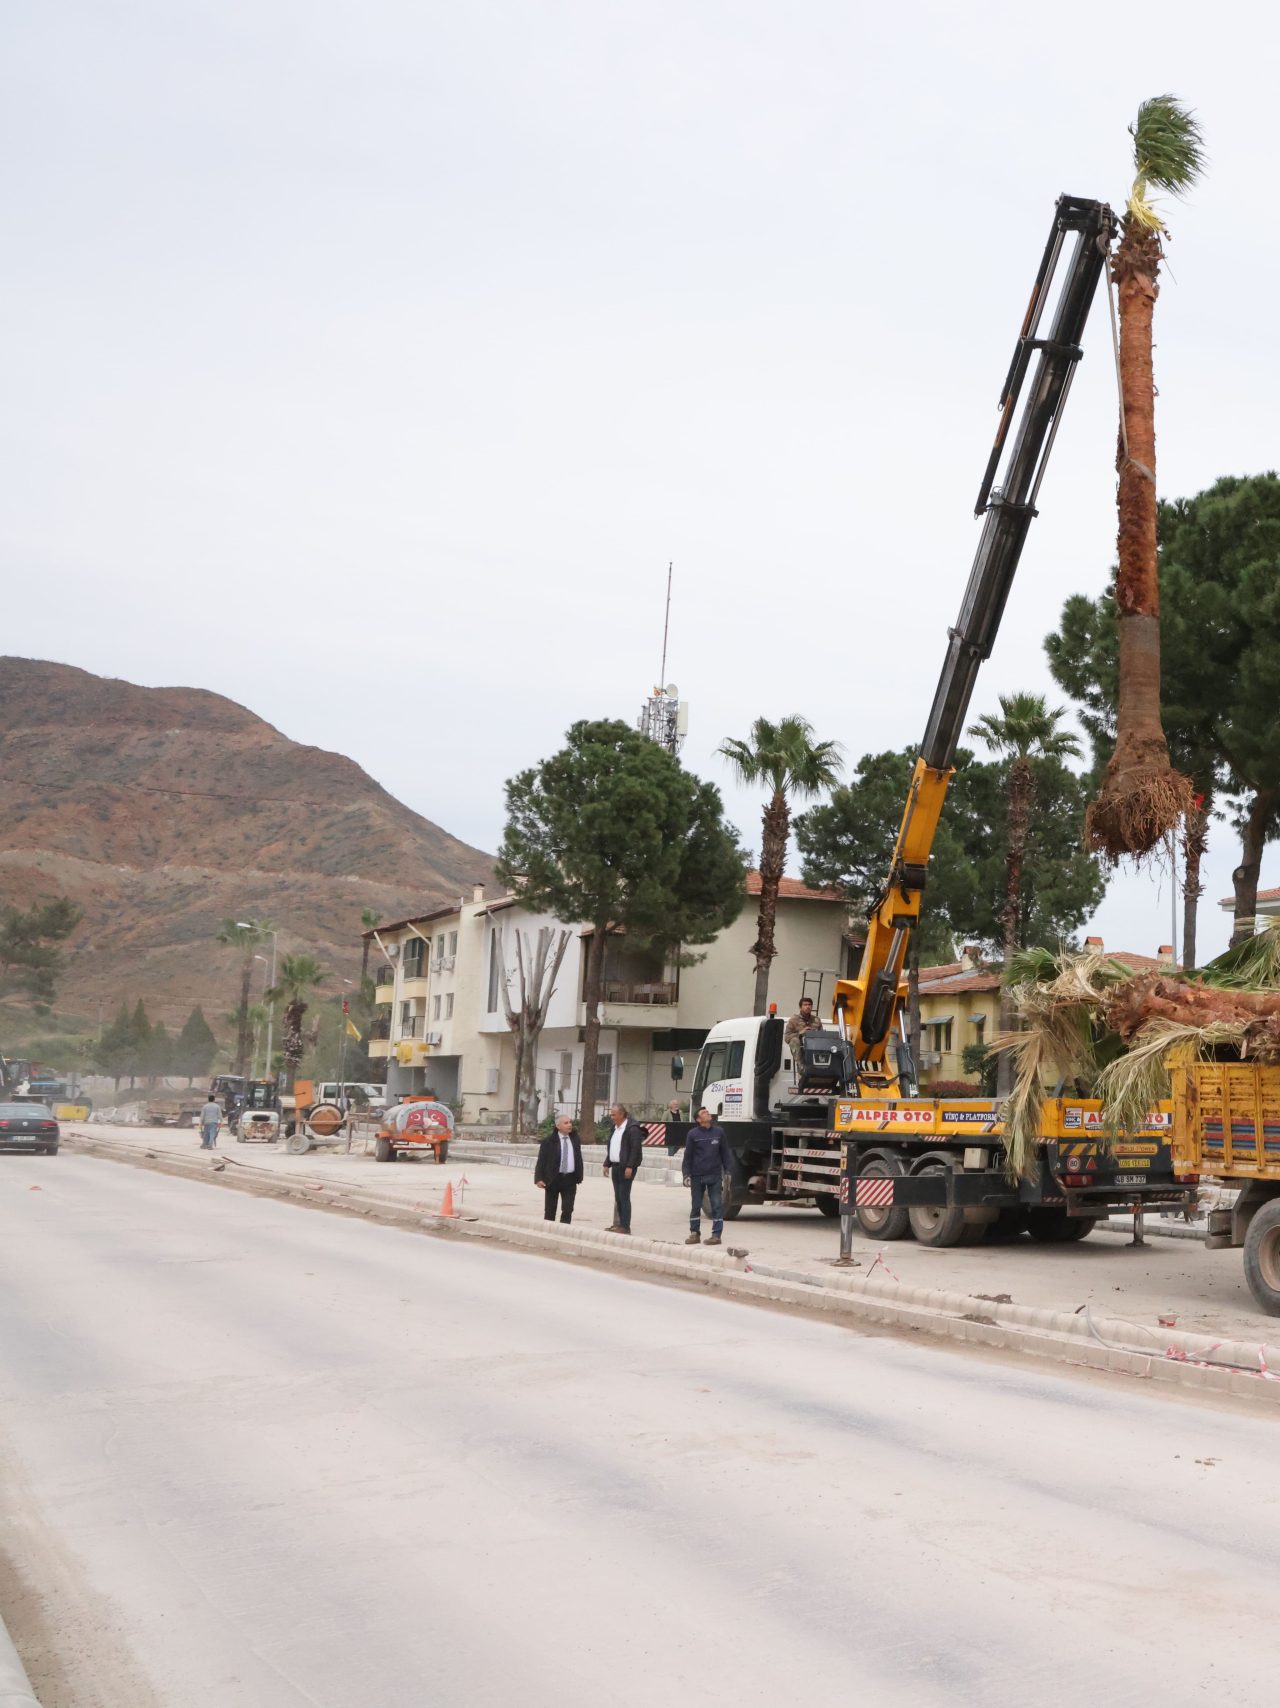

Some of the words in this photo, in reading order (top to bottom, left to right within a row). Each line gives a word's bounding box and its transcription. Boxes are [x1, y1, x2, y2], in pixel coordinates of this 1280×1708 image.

[856, 1111, 898, 1121] ALPER
[944, 1111, 958, 1122] VİNÇ
[959, 1113, 965, 1121] &
